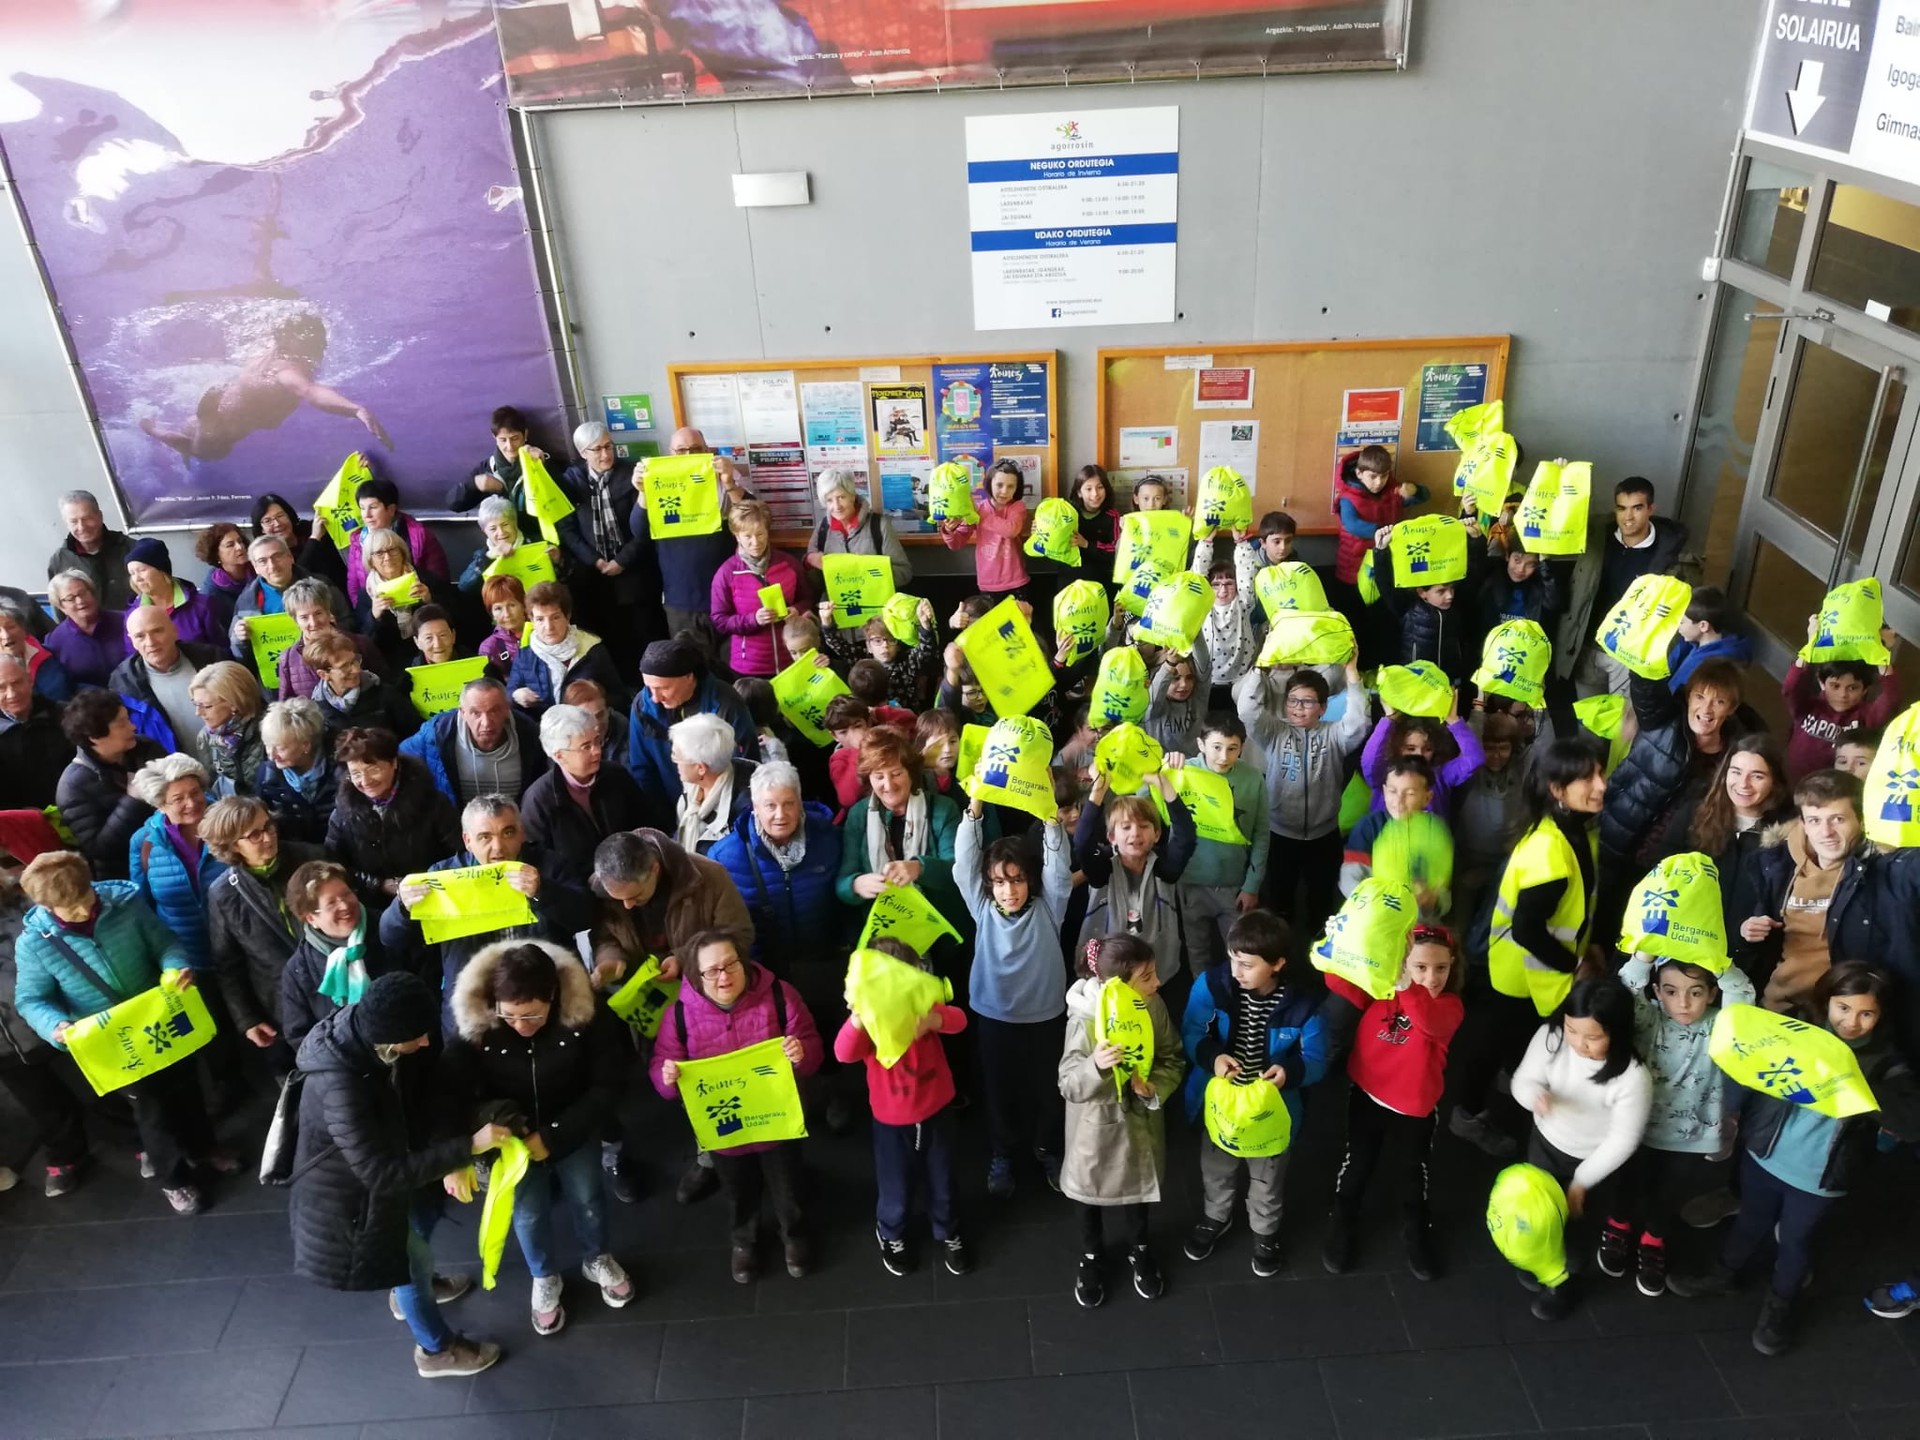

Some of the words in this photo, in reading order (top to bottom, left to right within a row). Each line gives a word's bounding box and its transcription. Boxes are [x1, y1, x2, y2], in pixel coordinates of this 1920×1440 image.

[1776, 13, 1860, 52] SOLAIRUA
[1030, 160, 1066, 171] NEGUKO
[1067, 158, 1115, 169] ORDUTEGIA
[1043, 170, 1065, 178] Horario
[1078, 169, 1102, 177] Invierno
[1035, 230, 1064, 240] UDAKO
[1066, 228, 1112, 238] ORDUTEGIA
[1046, 239, 1067, 247] Horario
[1672, 921, 1719, 941] Bergarako
[1670, 931, 1699, 945] Udala
[744, 1111, 787, 1122] Bergarako
[745, 1120, 770, 1128] Udala
